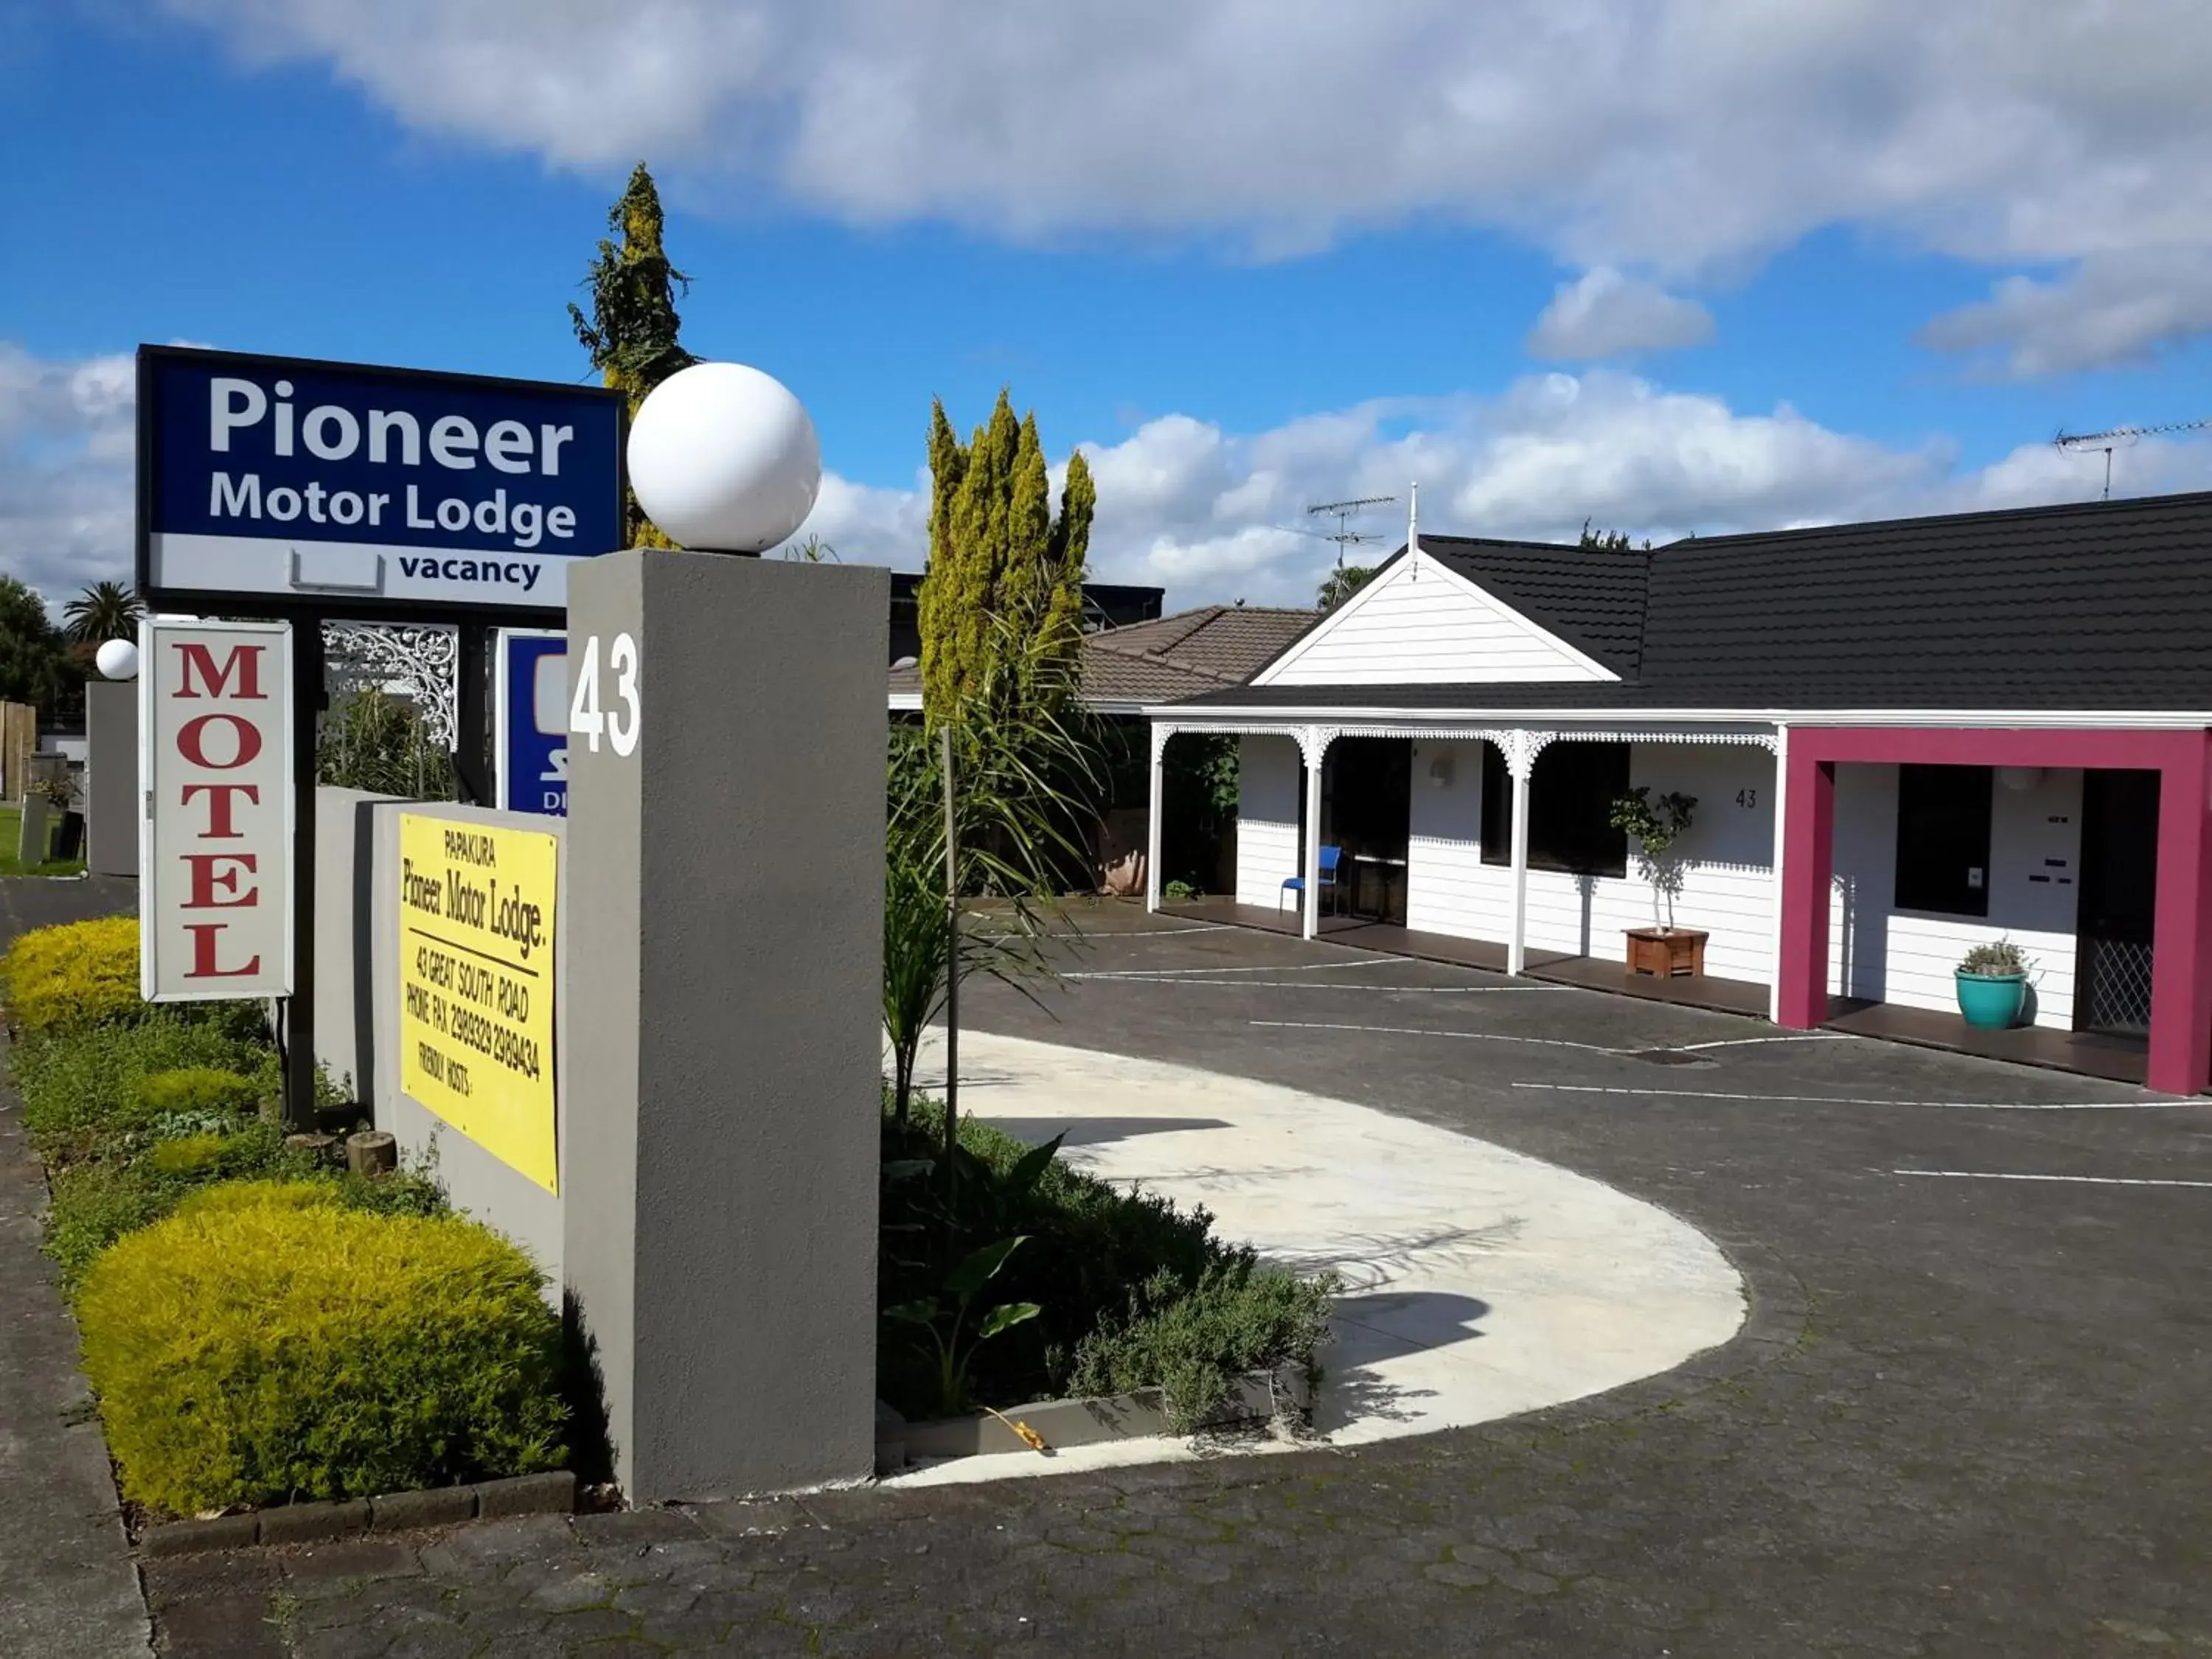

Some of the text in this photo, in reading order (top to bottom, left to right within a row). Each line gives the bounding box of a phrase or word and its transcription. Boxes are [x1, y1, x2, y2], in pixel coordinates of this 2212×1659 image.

[211, 378, 573, 476] Pioneer
[209, 471, 576, 547] Motor Lodge
[399, 557, 540, 591] vacancy
[570, 633, 641, 757] 43
[172, 644, 268, 978] MOTEL
[1736, 788, 1756, 809] 43
[445, 830, 495, 868] PAPAKURA
[403, 858, 442, 915] Pioneer
[446, 869, 486, 929] Motor
[417, 946, 529, 1023] 43 GREAT SOUTH ROAD
[406, 981, 430, 1024] PHONE
[433, 995, 449, 1035] FAX
[493, 1023, 540, 1082] 2989434
[419, 1041, 445, 1083] FRIENDLY
